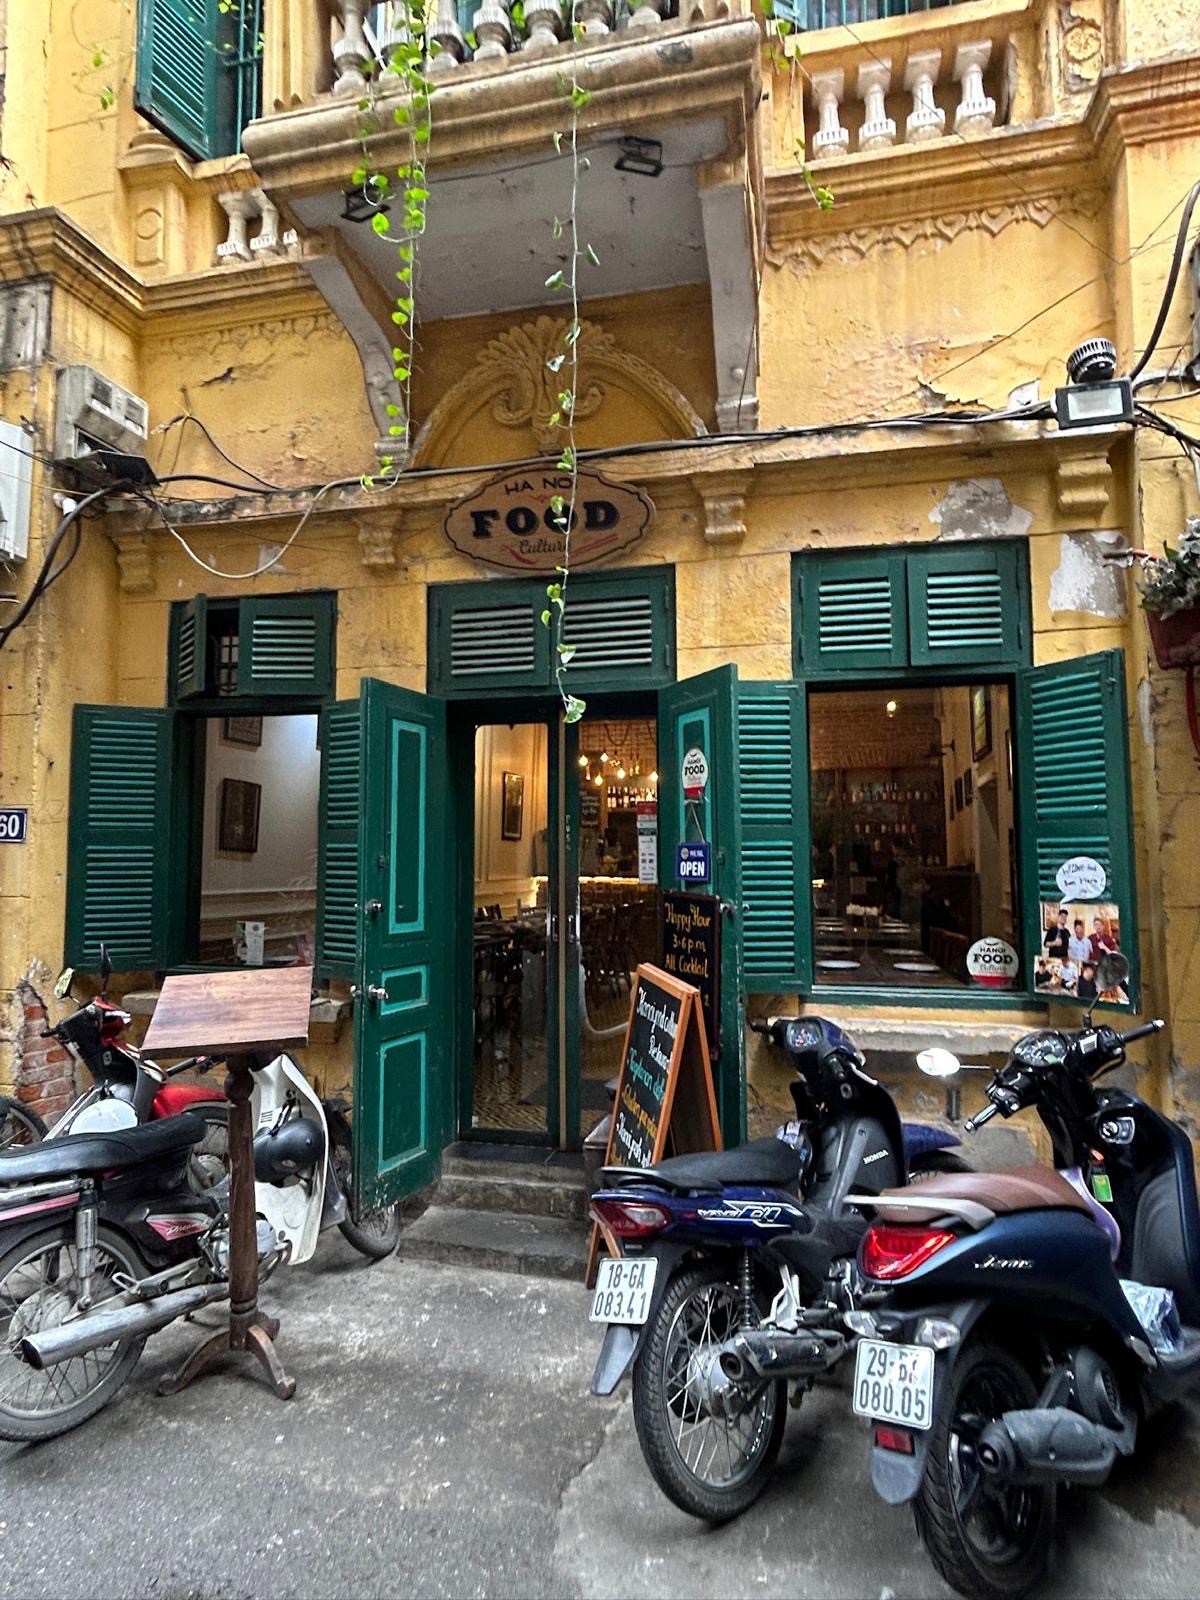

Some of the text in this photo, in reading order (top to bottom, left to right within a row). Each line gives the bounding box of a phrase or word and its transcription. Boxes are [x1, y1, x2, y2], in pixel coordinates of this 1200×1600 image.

[505, 477, 577, 495] HA NO
[470, 500, 621, 540] FOOD
[684, 764, 705, 776] FOOD
[680, 861, 705, 877] OPEN
[665, 903, 711, 932] Happy Hour
[665, 954, 709, 978] All Cocktail
[973, 954, 1013, 964] FOOD
[863, 1149, 889, 1165] HONDA
[608, 1263, 645, 1289] 18-GA
[594, 1291, 647, 1319] 083.41
